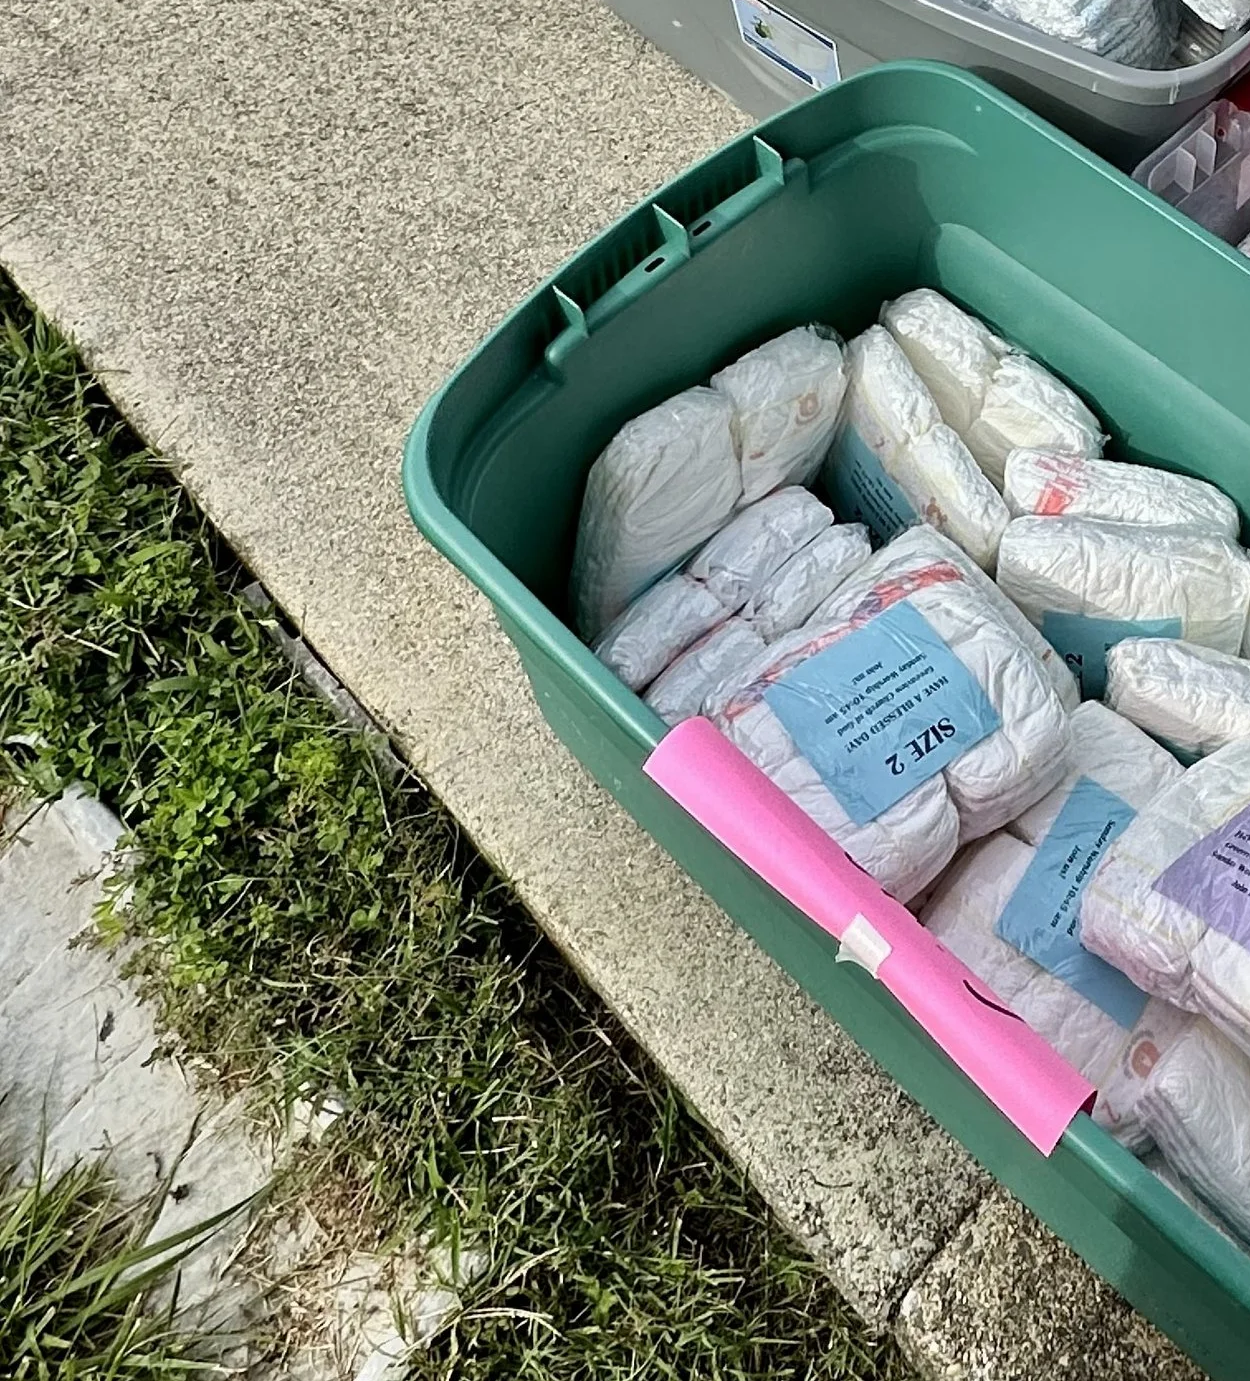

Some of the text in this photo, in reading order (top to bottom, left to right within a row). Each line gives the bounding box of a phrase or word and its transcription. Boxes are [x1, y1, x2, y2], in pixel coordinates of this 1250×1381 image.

[866, 661, 882, 675] Join
[824, 654, 926, 724] Sunday Worship 10:45 am
[844, 676, 948, 753] HAVE A BLESSED DAY!
[865, 692, 894, 715] Church
[837, 721, 854, 736] God
[854, 714, 864, 724] of
[885, 718, 955, 775] SIZE 2
[1095, 820, 1116, 848] Sunday
[1059, 845, 1081, 879] Join us!
[1075, 850, 1099, 883] Worship
[1231, 880, 1248, 893] Join
